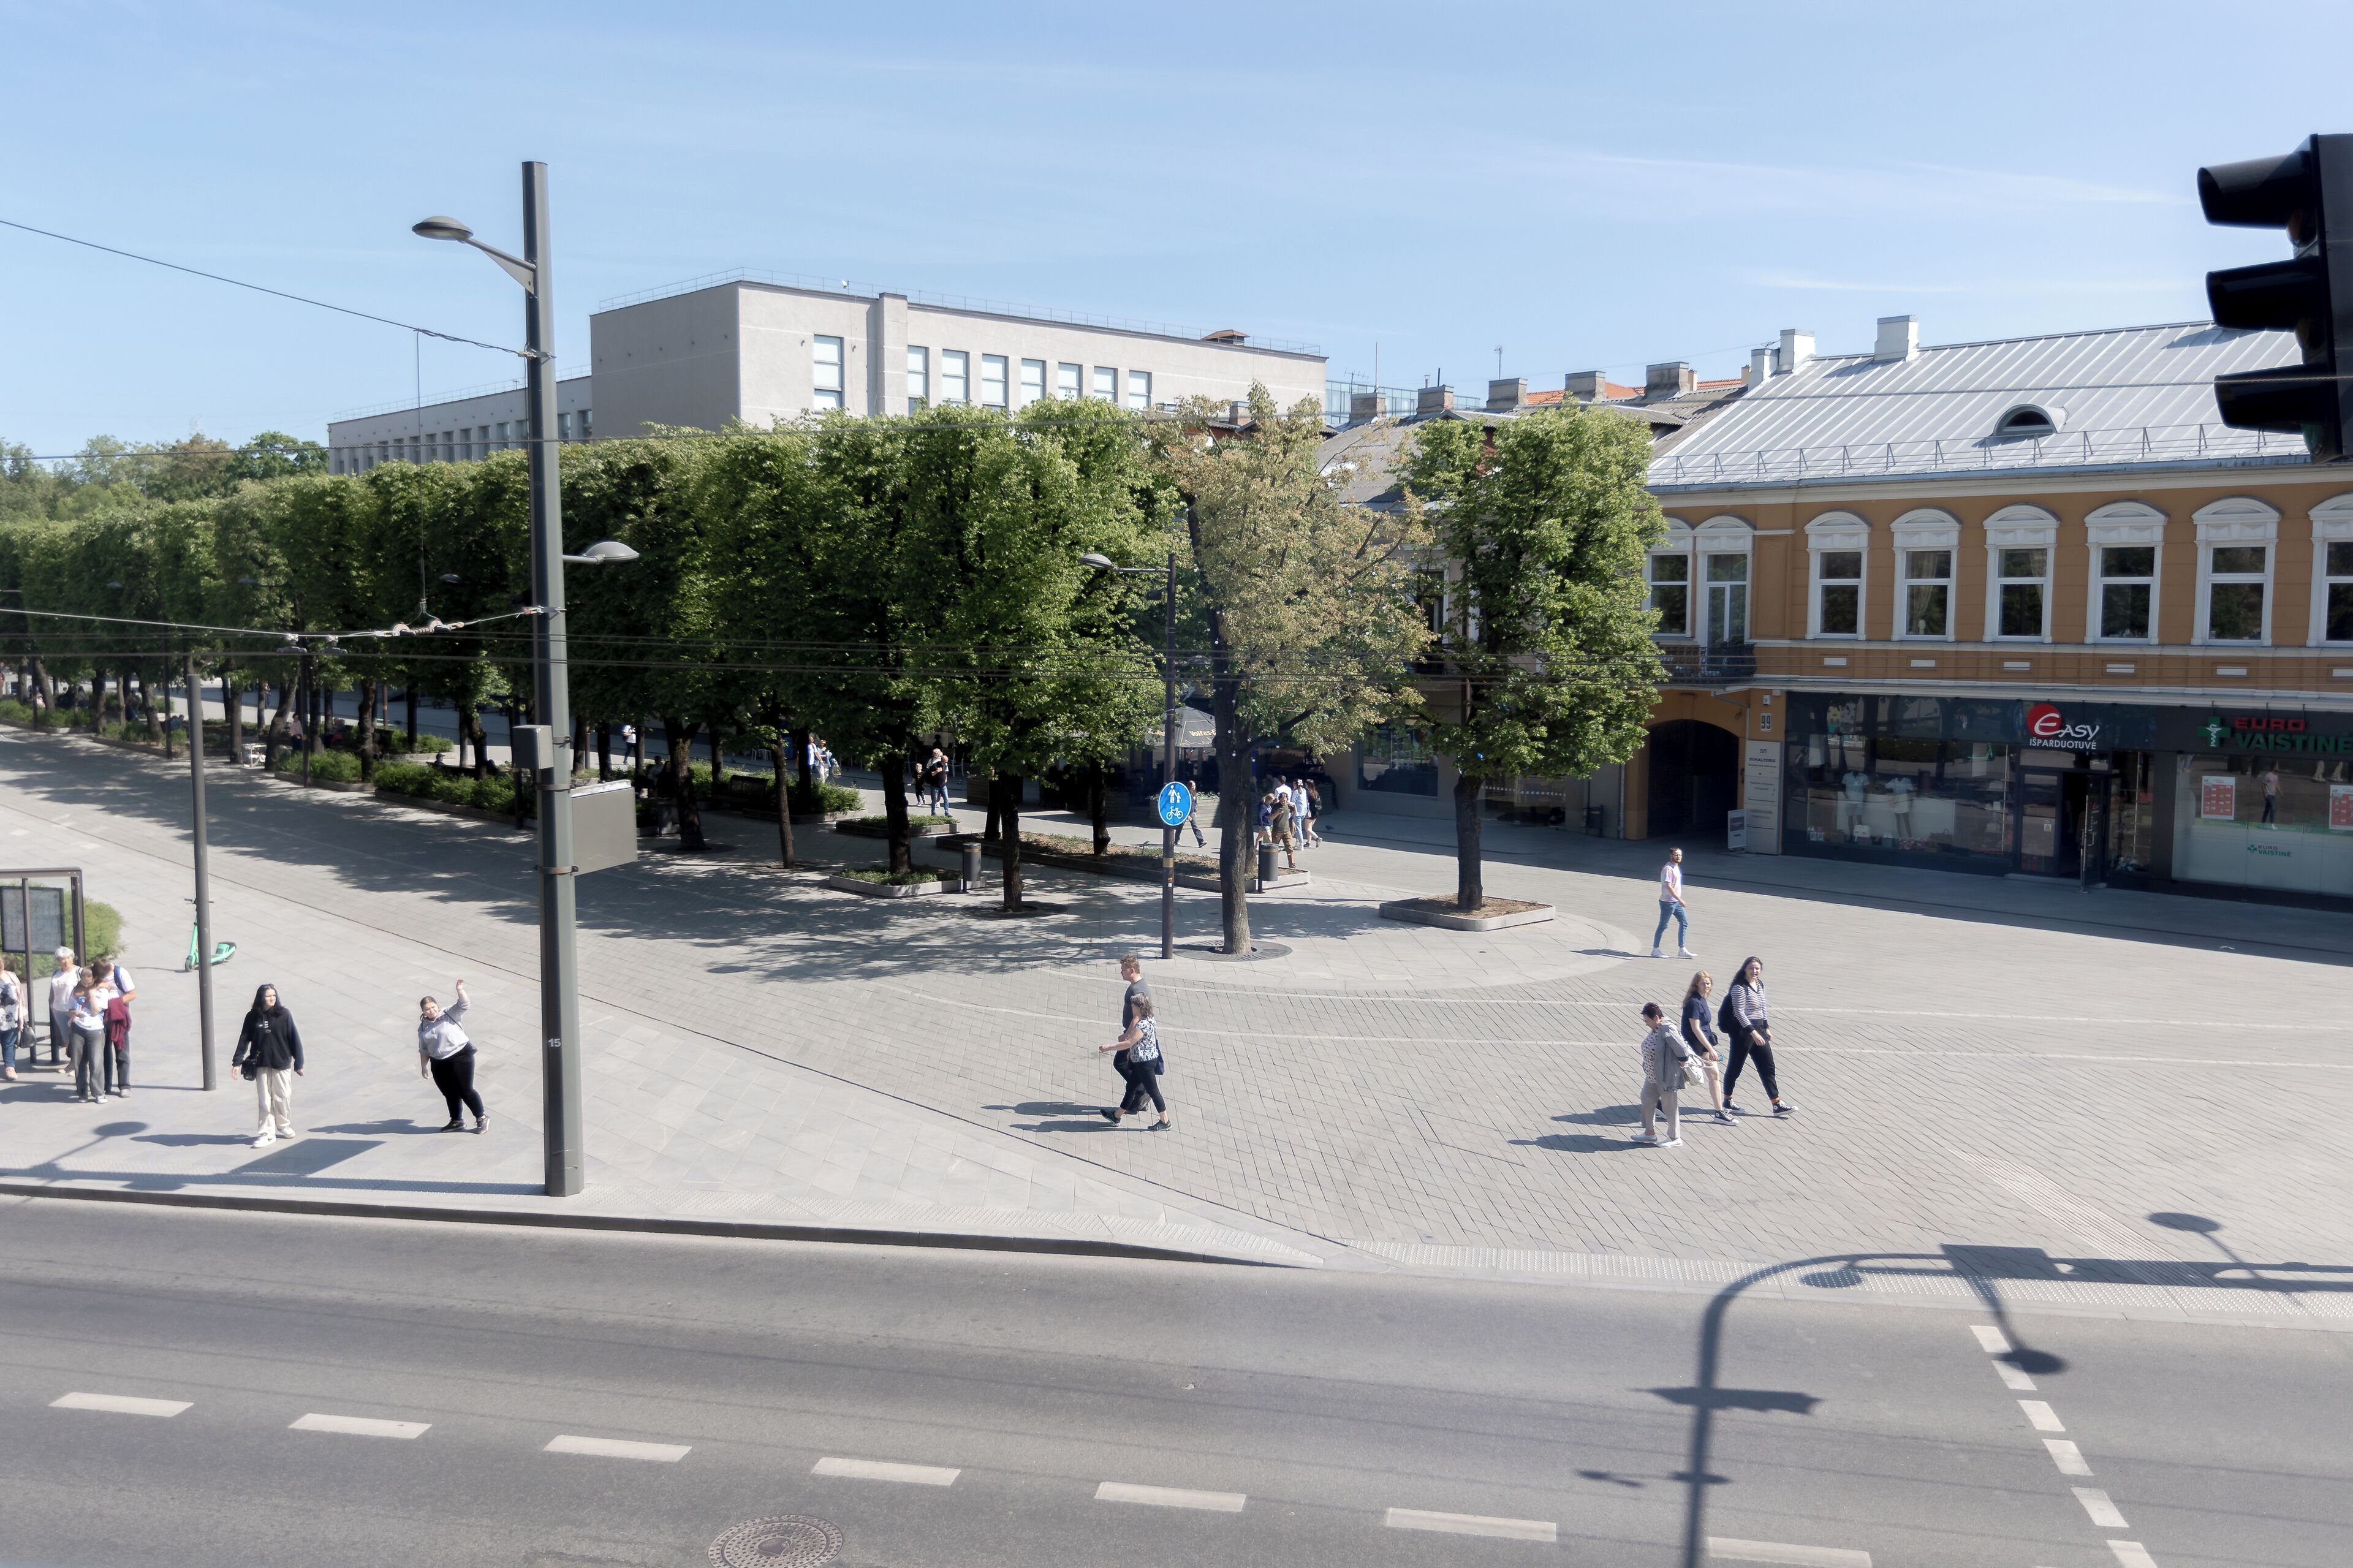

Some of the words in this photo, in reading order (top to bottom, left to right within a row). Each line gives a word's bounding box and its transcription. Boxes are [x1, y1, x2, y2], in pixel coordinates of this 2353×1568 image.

[1761, 715, 1771, 729] 99
[2235, 717, 2305, 732] EURO
[2029, 737, 2096, 750] IŠPARDUOTUVĖ
[2235, 732, 2353, 755] VAISTINĖ
[548, 1038, 561, 1047] 15
